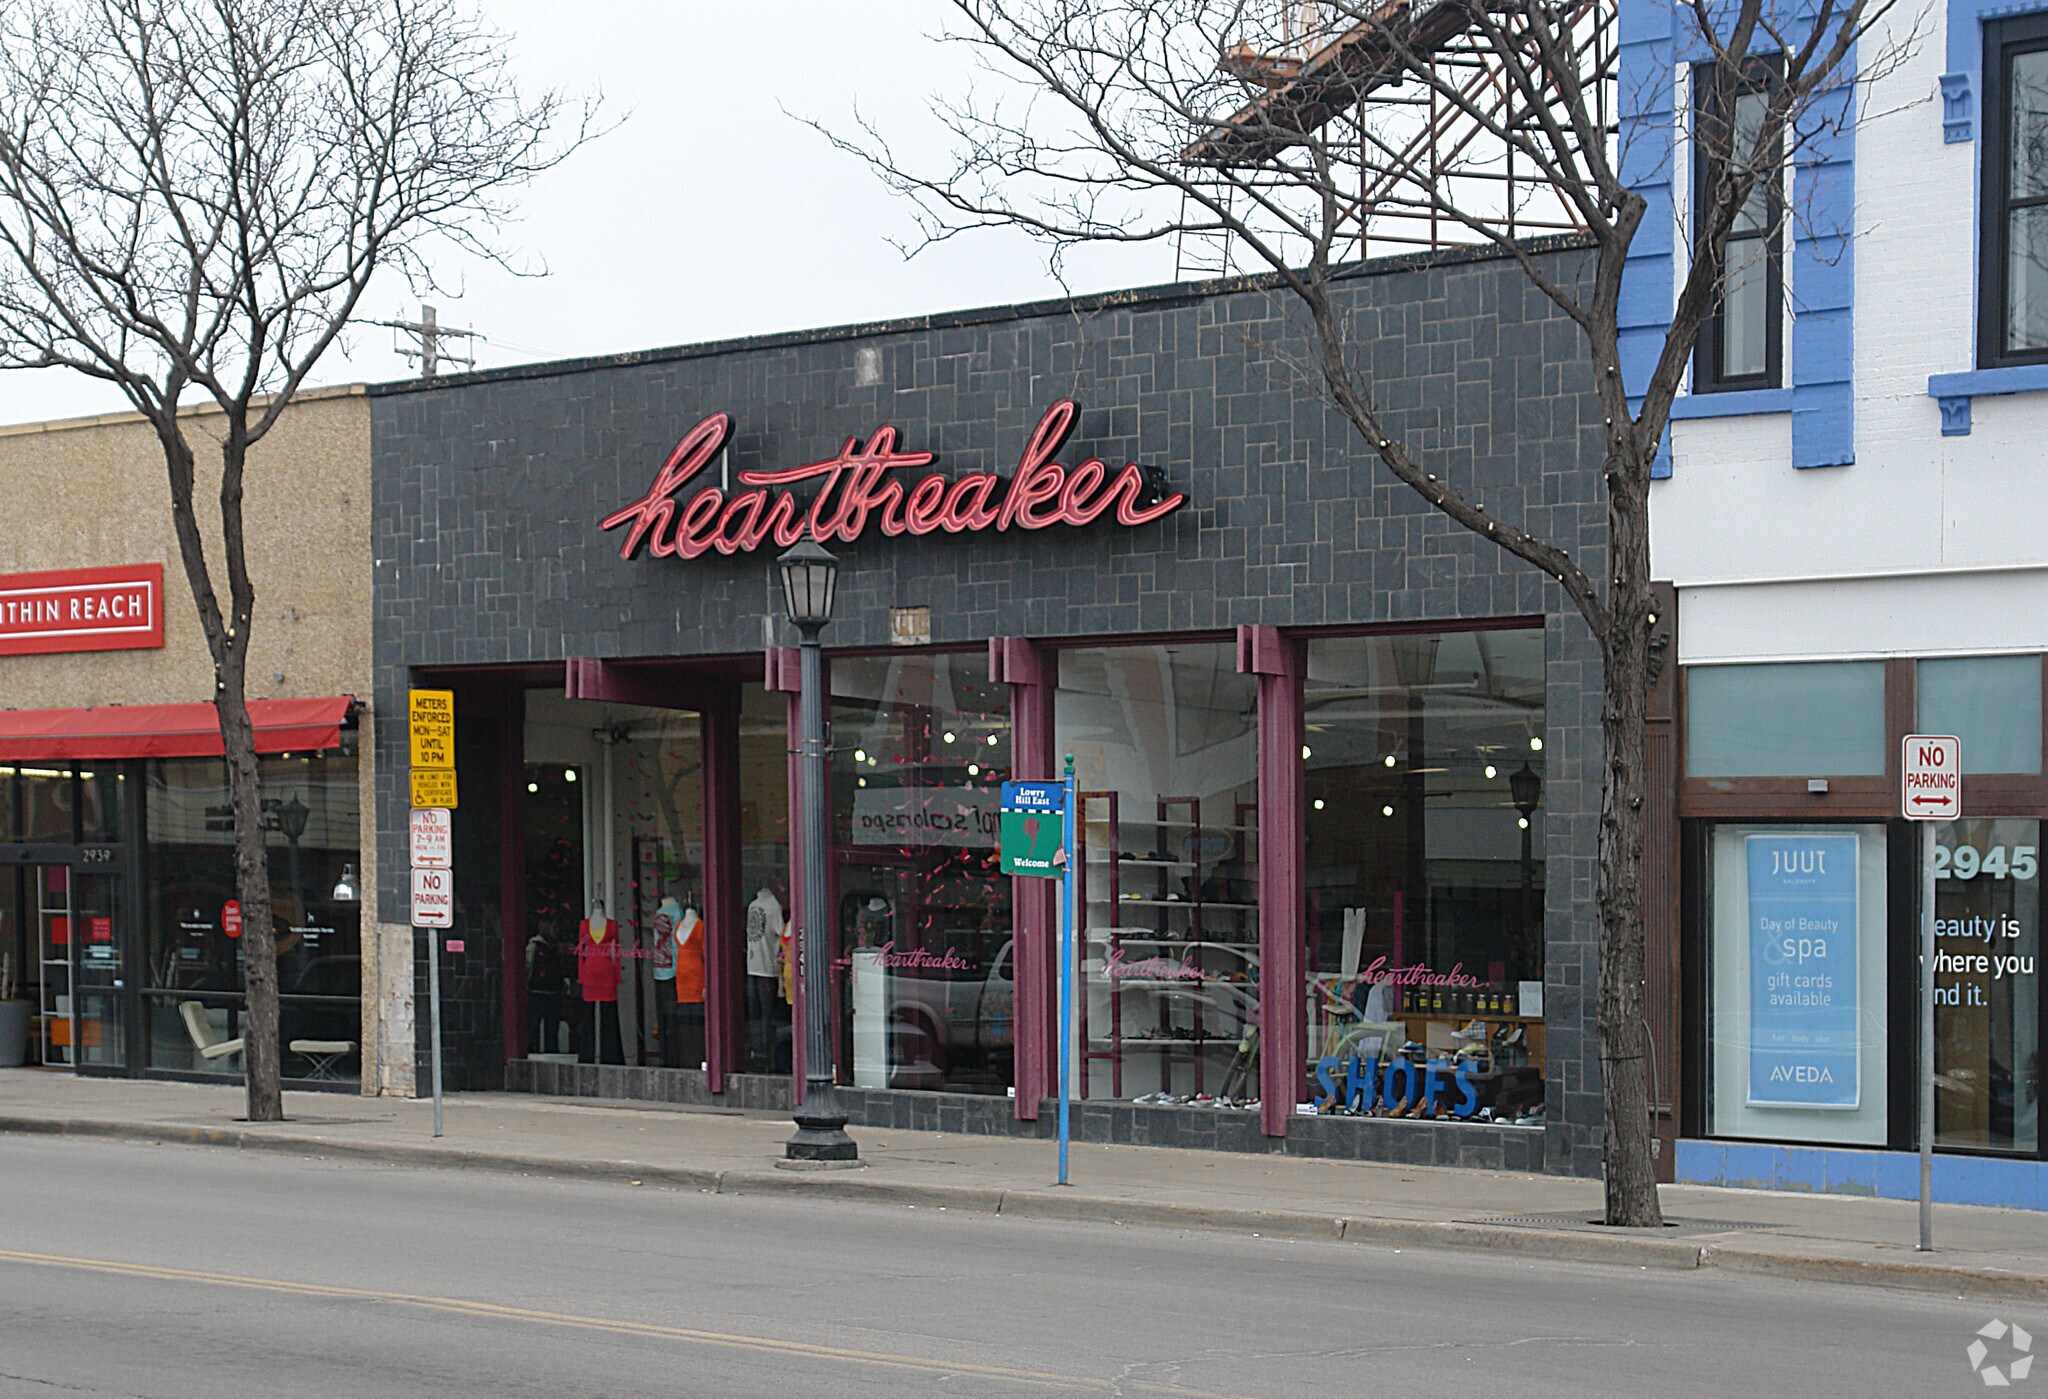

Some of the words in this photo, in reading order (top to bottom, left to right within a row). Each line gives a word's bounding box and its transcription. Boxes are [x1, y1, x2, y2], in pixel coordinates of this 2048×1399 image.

[599, 398, 1190, 561] heartbreaker
[70, 594, 142, 620] REACH
[416, 698, 447, 709] METERS
[412, 711, 451, 723] ENFORCED
[421, 738, 444, 750] UNTIL
[421, 751, 429, 762] 10
[431, 752, 445, 763] PM
[1919, 746, 1944, 767] NO
[1907, 773, 1956, 789] PARKING
[1015, 795, 1031, 804] Hill
[1032, 796, 1050, 805] East
[1020, 787, 1045, 798] Lowry
[423, 812, 437, 824] NO
[413, 824, 448, 834] PARKING
[83, 849, 111, 862] 2939
[1013, 857, 1050, 868] Welcome
[1772, 850, 1826, 875] JUUT
[1934, 845, 2038, 880] 2945
[423, 875, 441, 889] NO
[415, 893, 448, 905] PARKING
[1760, 917, 1782, 933] Day
[1784, 918, 1795, 930] of
[1799, 918, 1839, 934] Beauty
[2001, 913, 2021, 938] is
[1783, 938, 1827, 965] spa
[1994, 955, 2034, 980] you
[1768, 972, 1790, 991] gift
[1794, 973, 1833, 988] cards
[1769, 992, 1831, 1006] available
[1967, 982, 1988, 1006] it.
[1770, 1065, 1834, 1083] AVEDA
